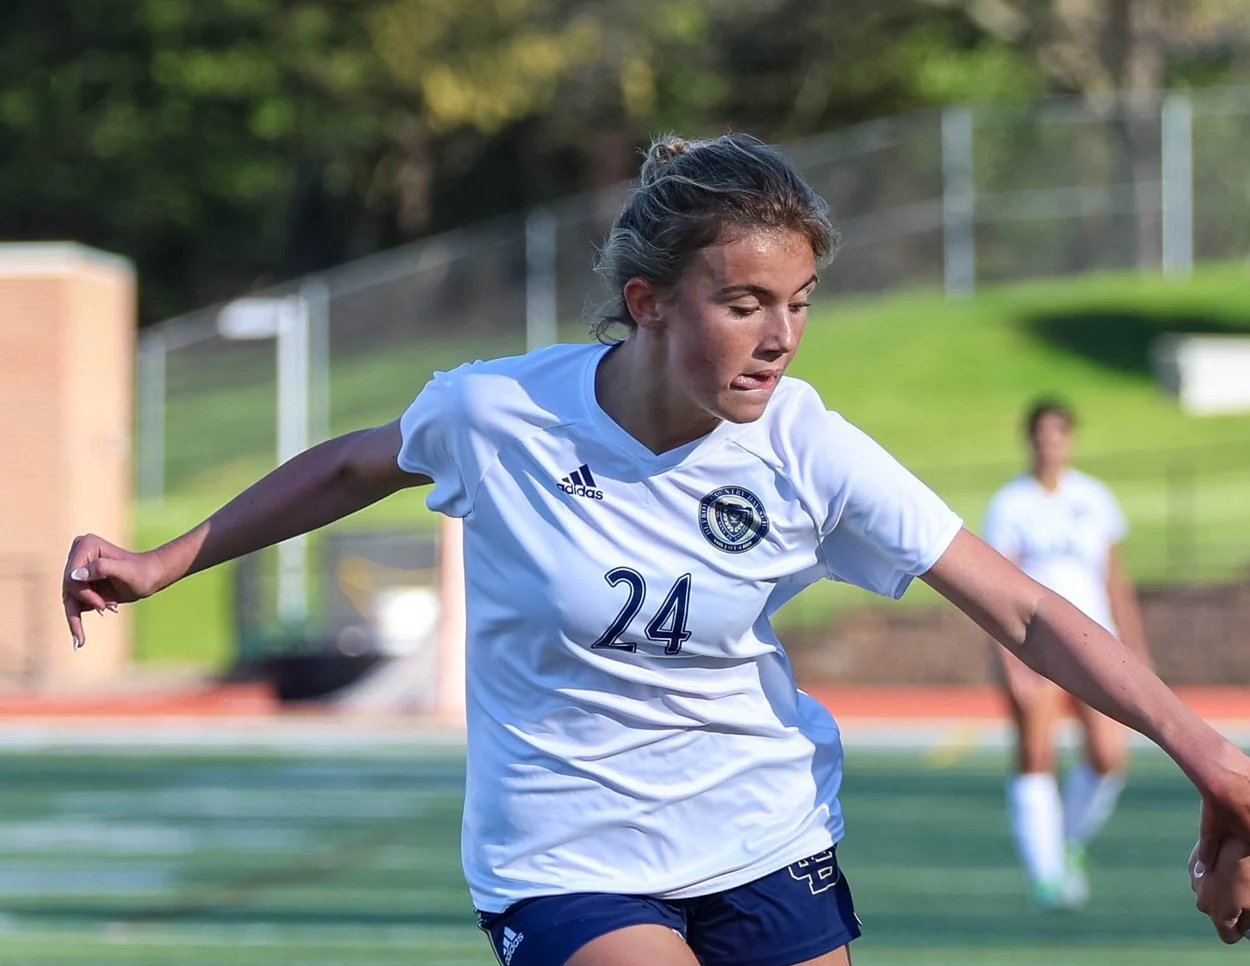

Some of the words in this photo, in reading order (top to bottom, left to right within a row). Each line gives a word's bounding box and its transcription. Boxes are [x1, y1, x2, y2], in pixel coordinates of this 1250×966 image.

[556, 483, 604, 500] adidas
[591, 566, 692, 655] 24
[504, 932, 524, 966] adidas
